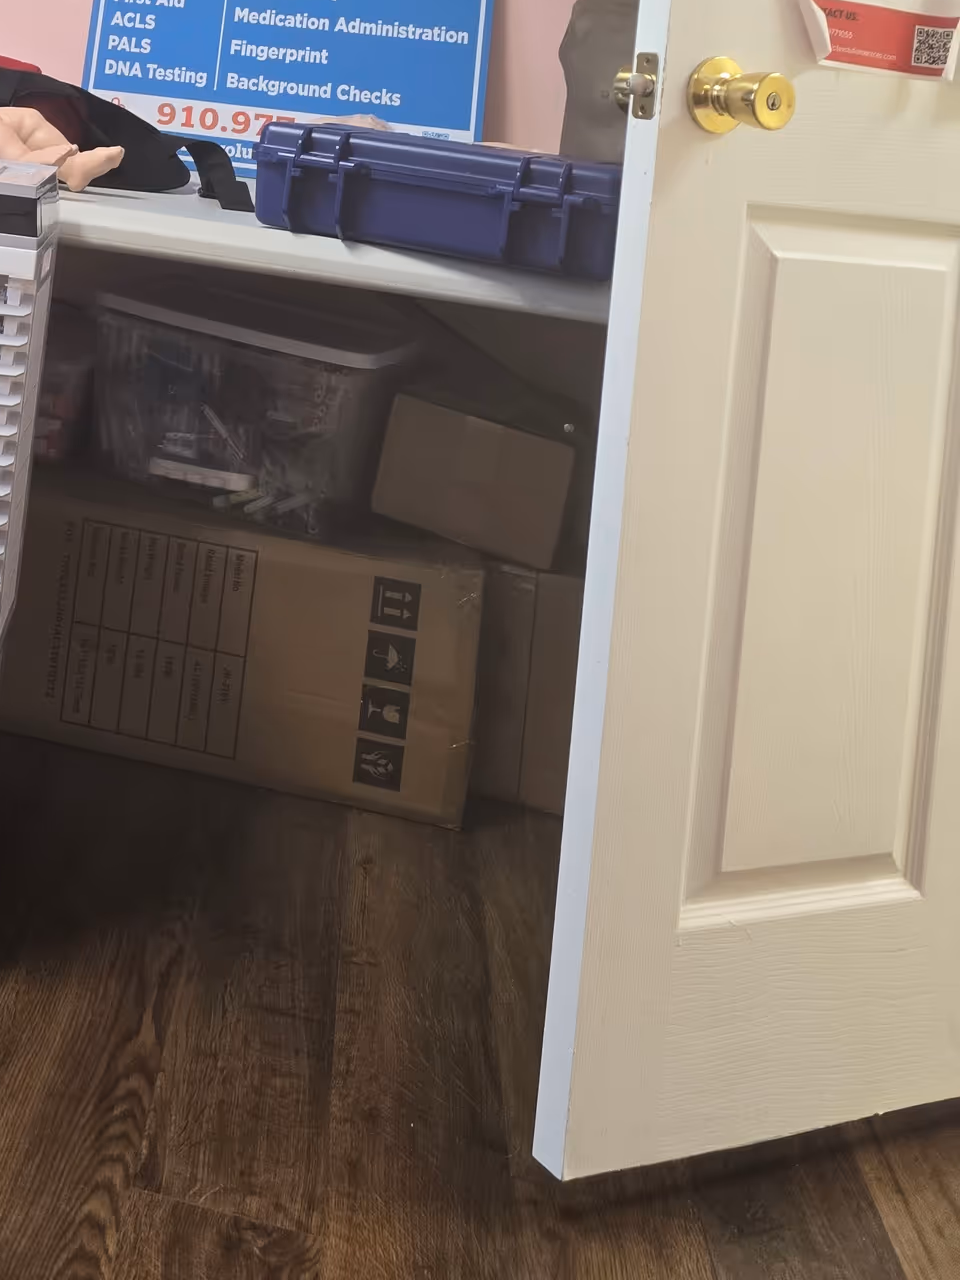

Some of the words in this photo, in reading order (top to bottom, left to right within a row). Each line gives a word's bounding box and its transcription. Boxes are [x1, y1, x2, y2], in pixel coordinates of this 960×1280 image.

[110, 11, 156, 30] ACLS
[233, 6, 330, 32] Medication
[334, 16, 470, 46] Administration
[107, 35, 152, 54] PALS
[230, 39, 329, 65] Fingerprint
[104, 58, 142, 79] DNA
[147, 63, 208, 87] Testing
[225, 72, 332, 100] Background
[336, 84, 402, 107] Checks
